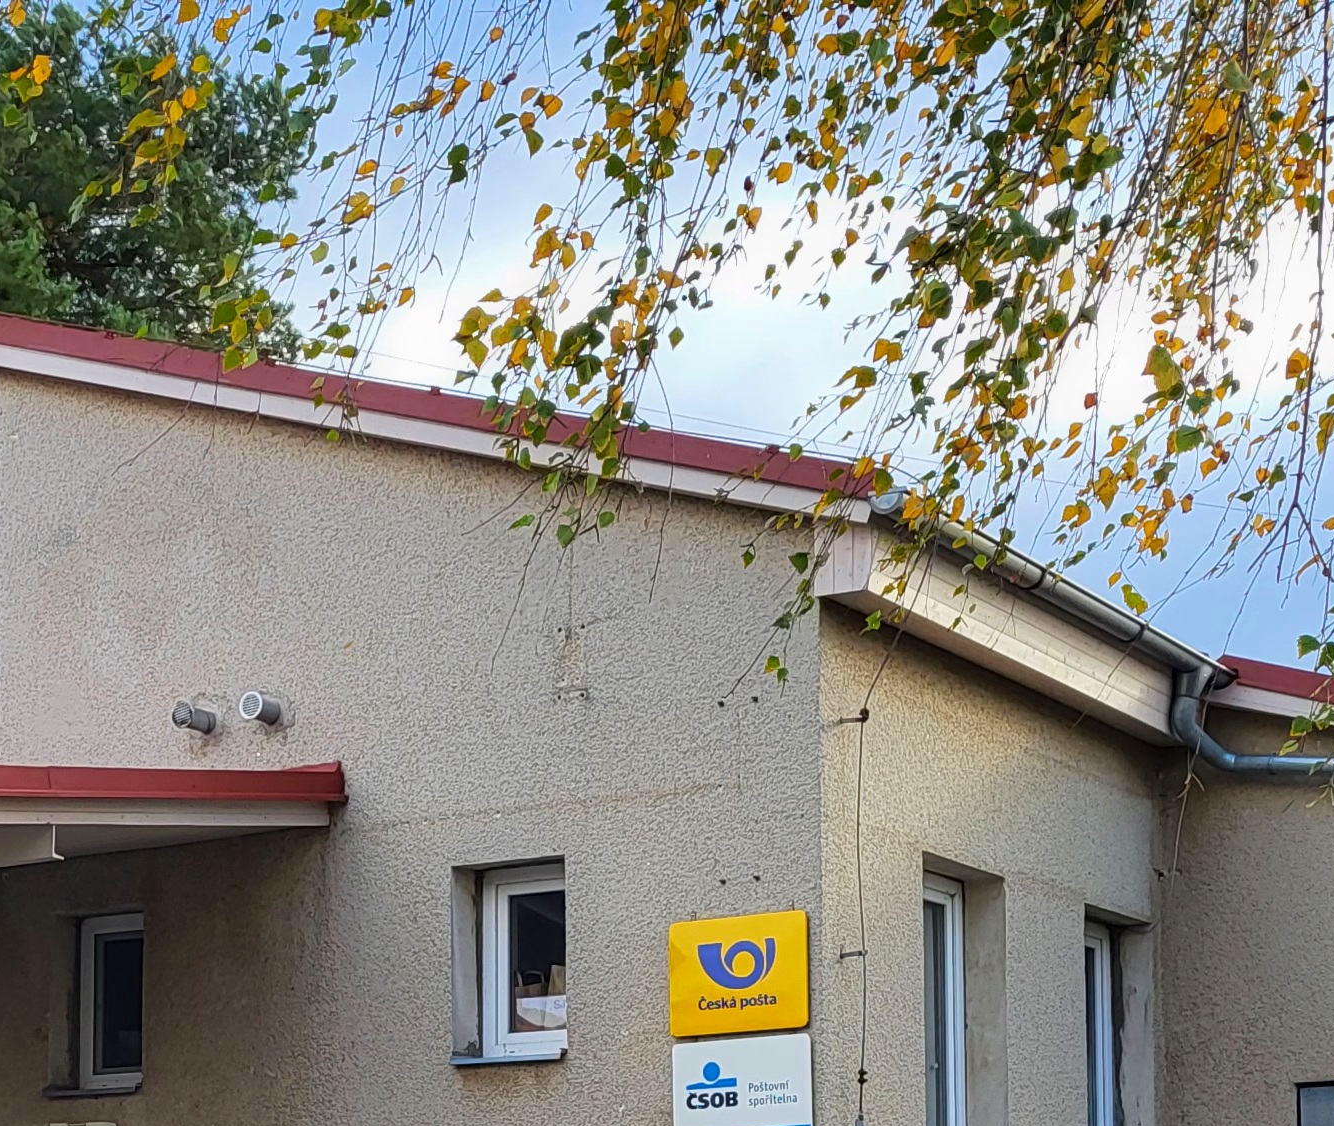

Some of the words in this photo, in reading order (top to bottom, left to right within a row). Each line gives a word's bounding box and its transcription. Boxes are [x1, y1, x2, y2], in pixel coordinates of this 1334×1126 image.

[698, 996, 737, 1011] Česká
[740, 993, 777, 1010] pošta
[748, 1080, 790, 1093] Poštovní
[686, 1091, 739, 1110] ČSOB
[748, 1093, 798, 1108] spořitelna
